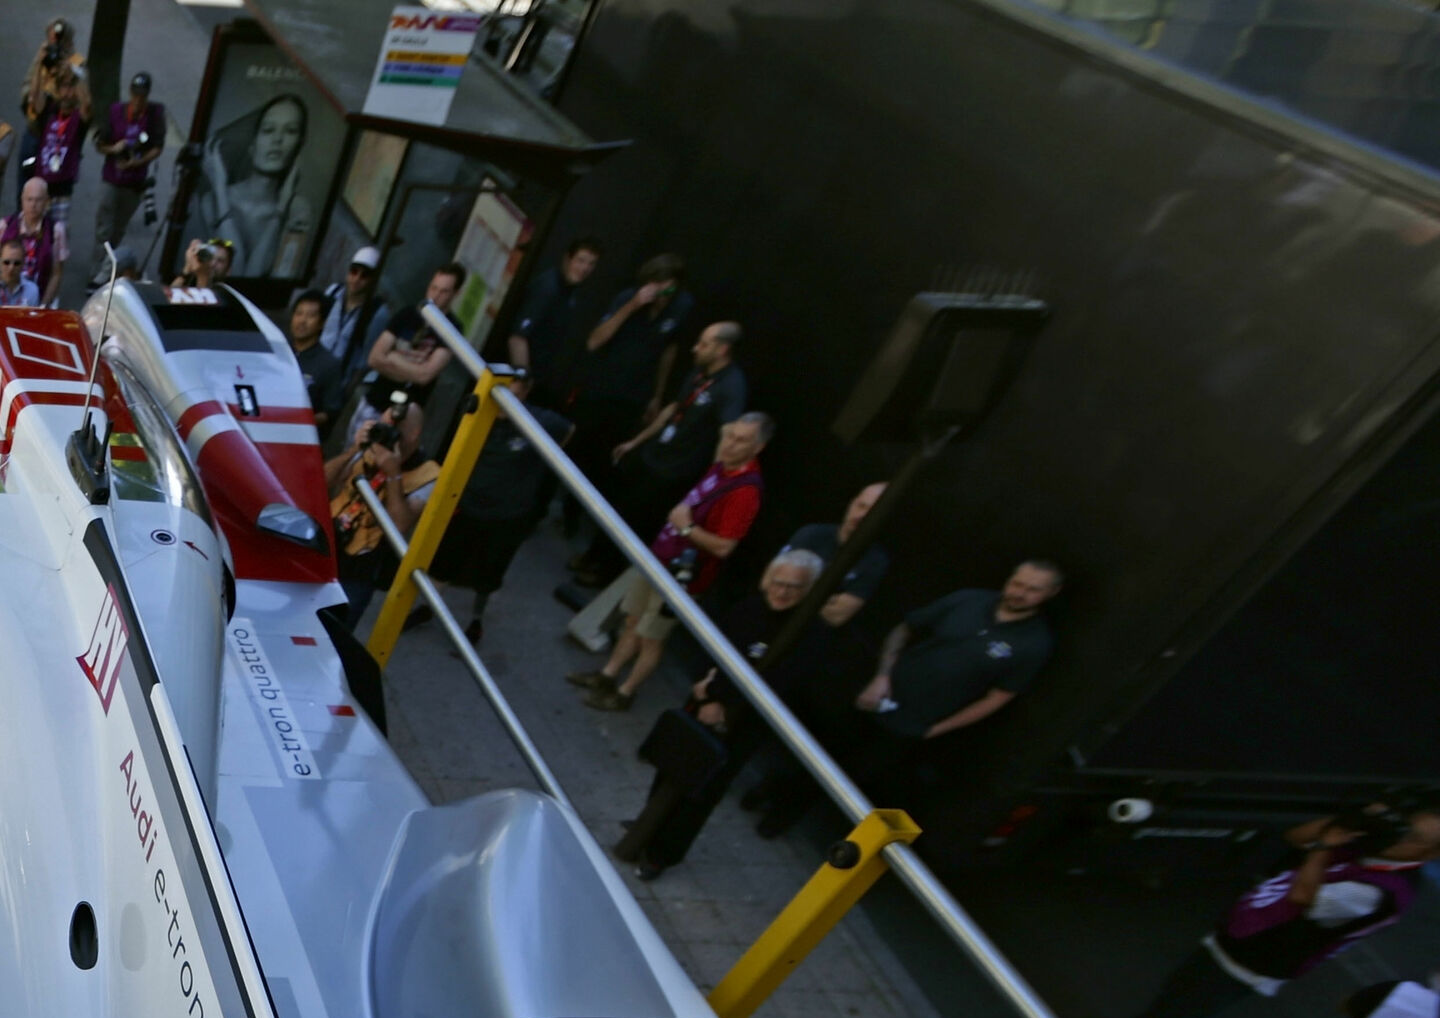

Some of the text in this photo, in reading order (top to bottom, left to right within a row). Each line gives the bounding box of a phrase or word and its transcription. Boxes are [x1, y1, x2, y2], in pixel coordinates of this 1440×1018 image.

[233, 628, 312, 777] e-tron quattro
[119, 750, 158, 864] Audi
